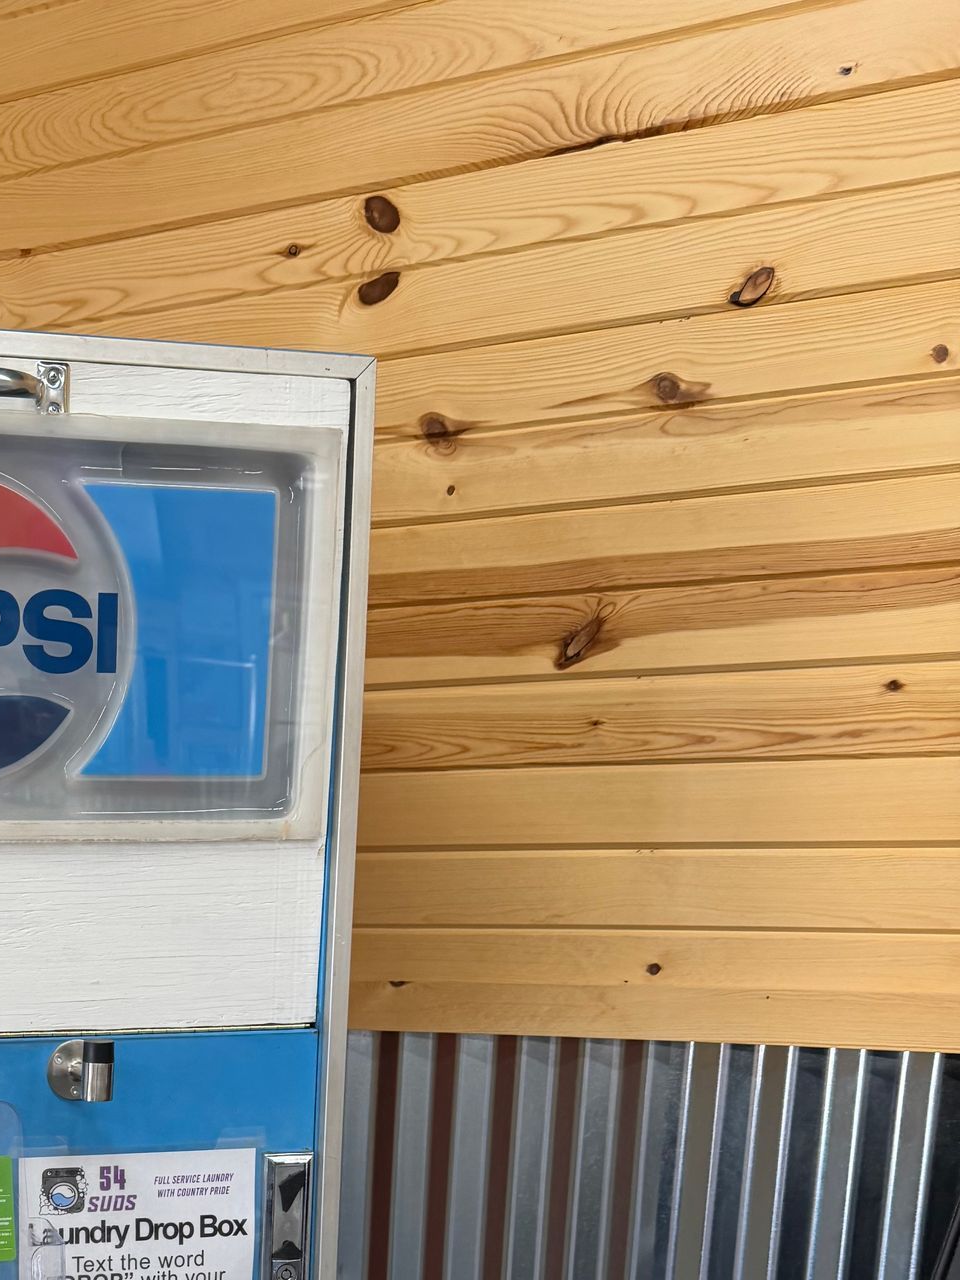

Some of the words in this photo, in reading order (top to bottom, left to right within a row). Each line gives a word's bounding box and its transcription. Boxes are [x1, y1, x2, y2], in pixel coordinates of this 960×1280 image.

[99, 1165, 127, 1191] 54
[153, 1175, 171, 1185] FULL
[172, 1174, 201, 1184] SERVICE
[202, 1172, 234, 1183] LAUNDRY
[157, 1188, 176, 1198] WITH
[177, 1187, 209, 1197] COUNTRY
[210, 1185, 230, 1195] PRIDE
[87, 1194, 138, 1213] SUDS
[134, 1217, 194, 1245] Drop
[200, 1214, 248, 1238] Box
[72, 1256, 113, 1272] Text
[120, 1253, 151, 1271] the
[158, 1250, 205, 1268] word
